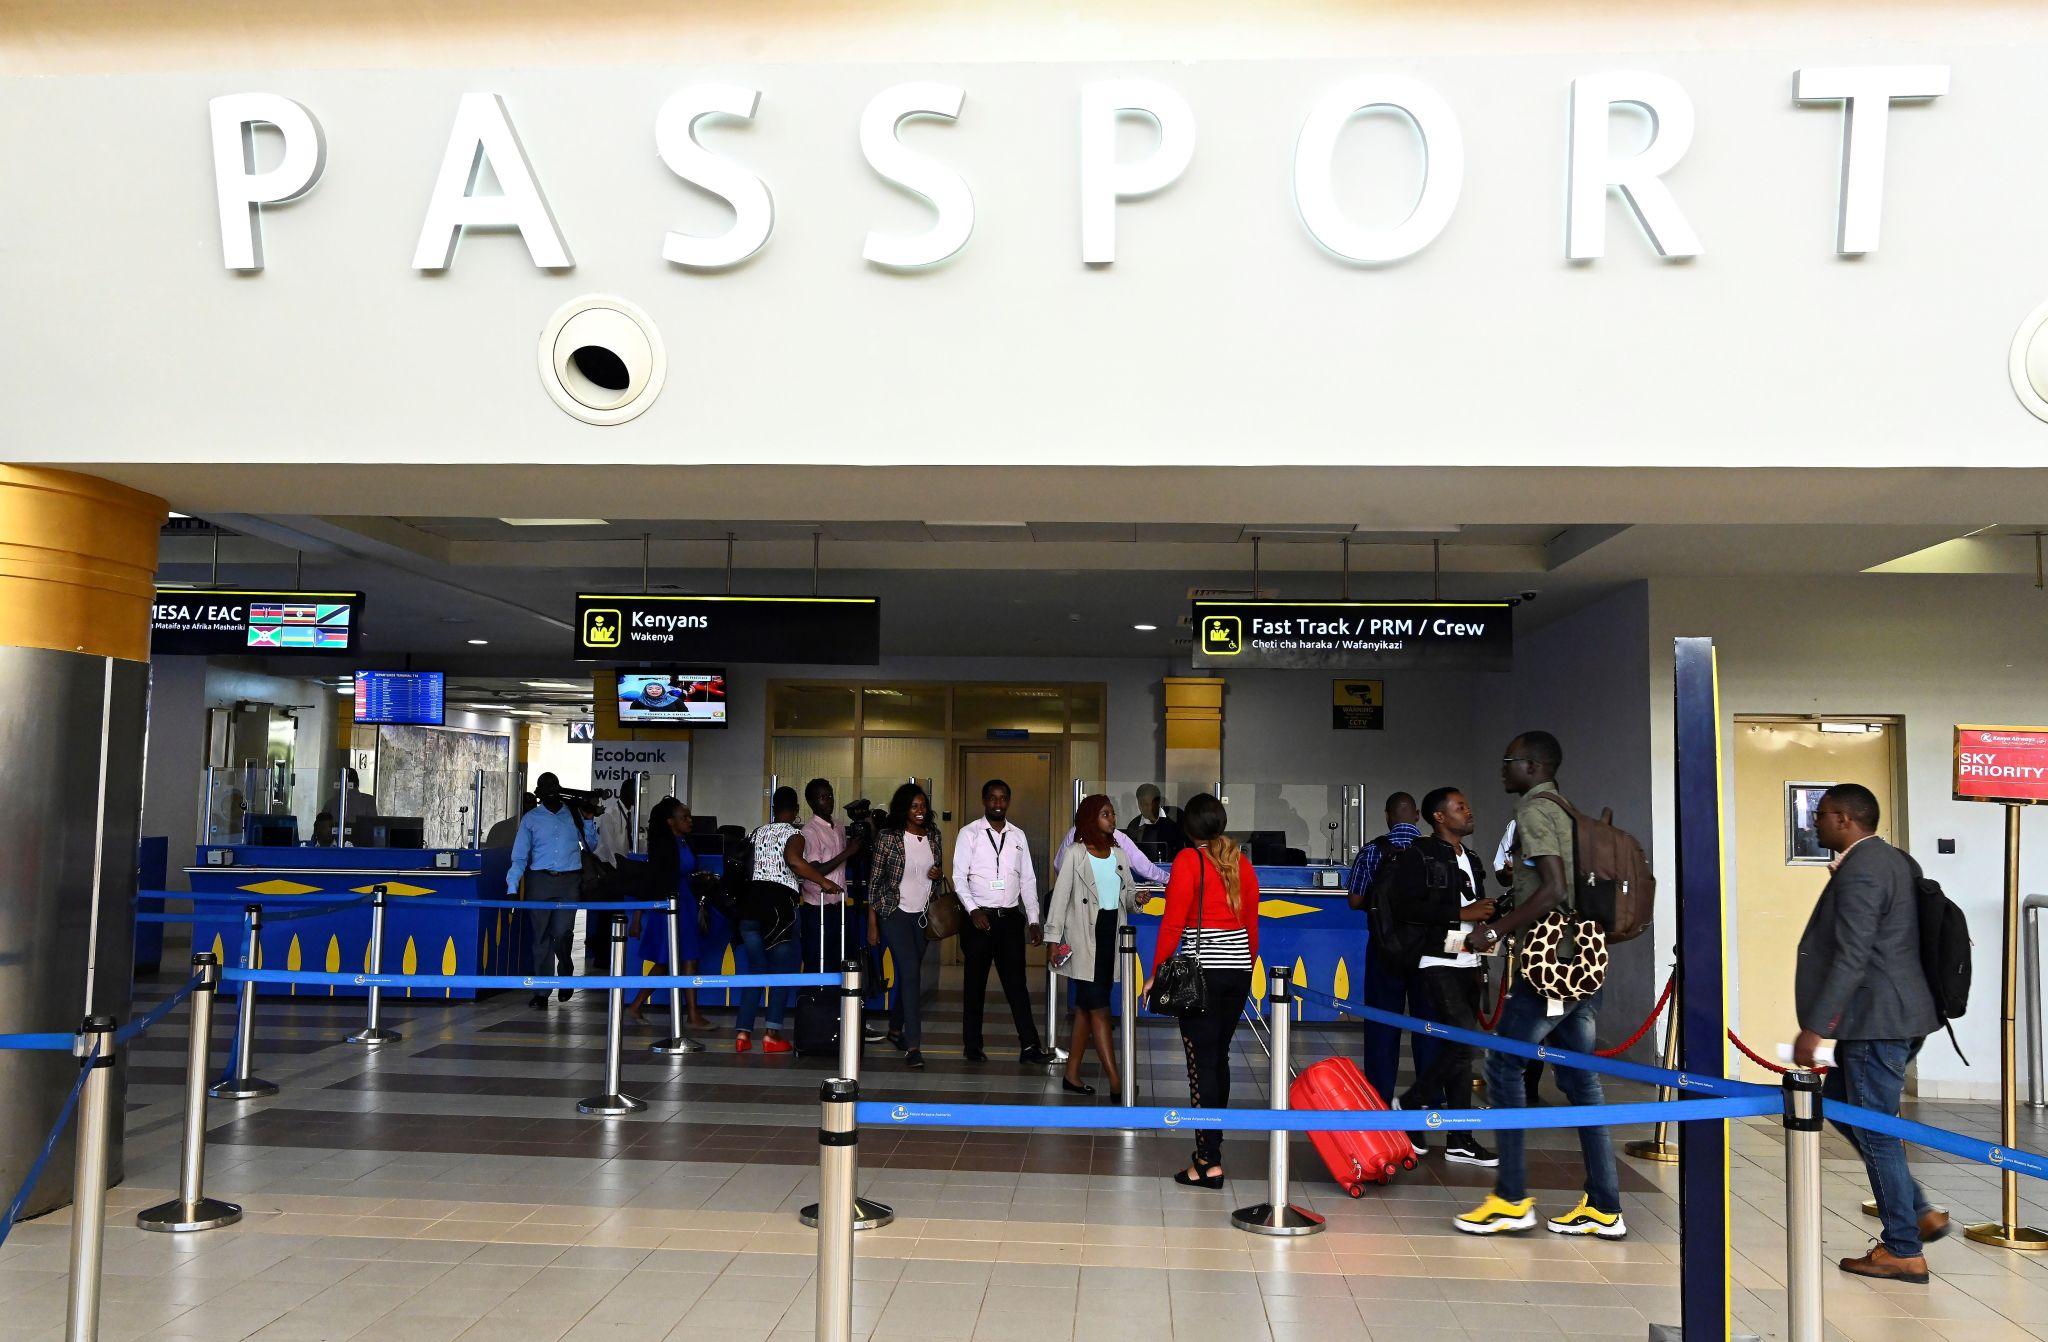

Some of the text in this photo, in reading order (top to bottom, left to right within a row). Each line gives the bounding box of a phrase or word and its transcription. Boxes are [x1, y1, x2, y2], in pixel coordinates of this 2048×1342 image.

[208, 63, 1952, 272] PASSPORT
[194, 605, 204, 621] /
[208, 606, 242, 621] EAC
[155, 622, 181, 630] Mataifa
[182, 623, 190, 631] ya
[213, 623, 246, 631] Mashariki
[632, 611, 708, 632] Kenyans
[1253, 617, 1485, 636] Fast Track / PRM / Crew
[630, 632, 674, 643] Wakenya
[1280, 640, 1297, 649] cha
[1300, 640, 1333, 649] haraka
[1342, 640, 1403, 652] Wafanyikazi
[594, 747, 667, 762] Ecobank
[1960, 753, 1996, 765] SKY
[1960, 764, 2045, 779] PRIORITY
